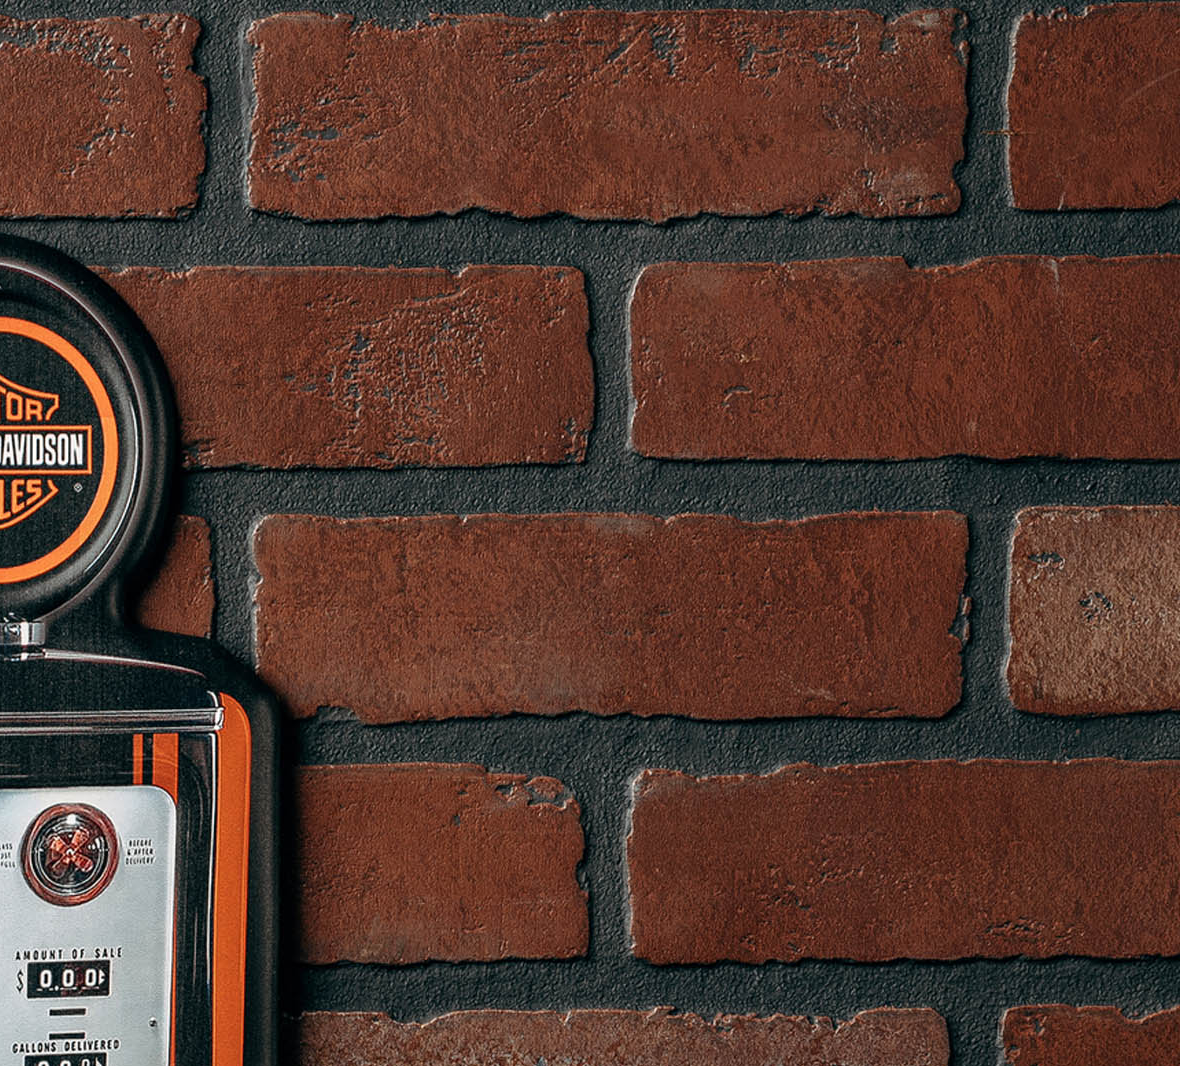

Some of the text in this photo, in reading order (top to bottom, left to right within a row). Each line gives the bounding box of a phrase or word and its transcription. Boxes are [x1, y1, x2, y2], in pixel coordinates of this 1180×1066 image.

[15, 947, 122, 961] AMOUNT OF SALE
[12, 1039, 120, 1054] GALLONS DELIVERED
